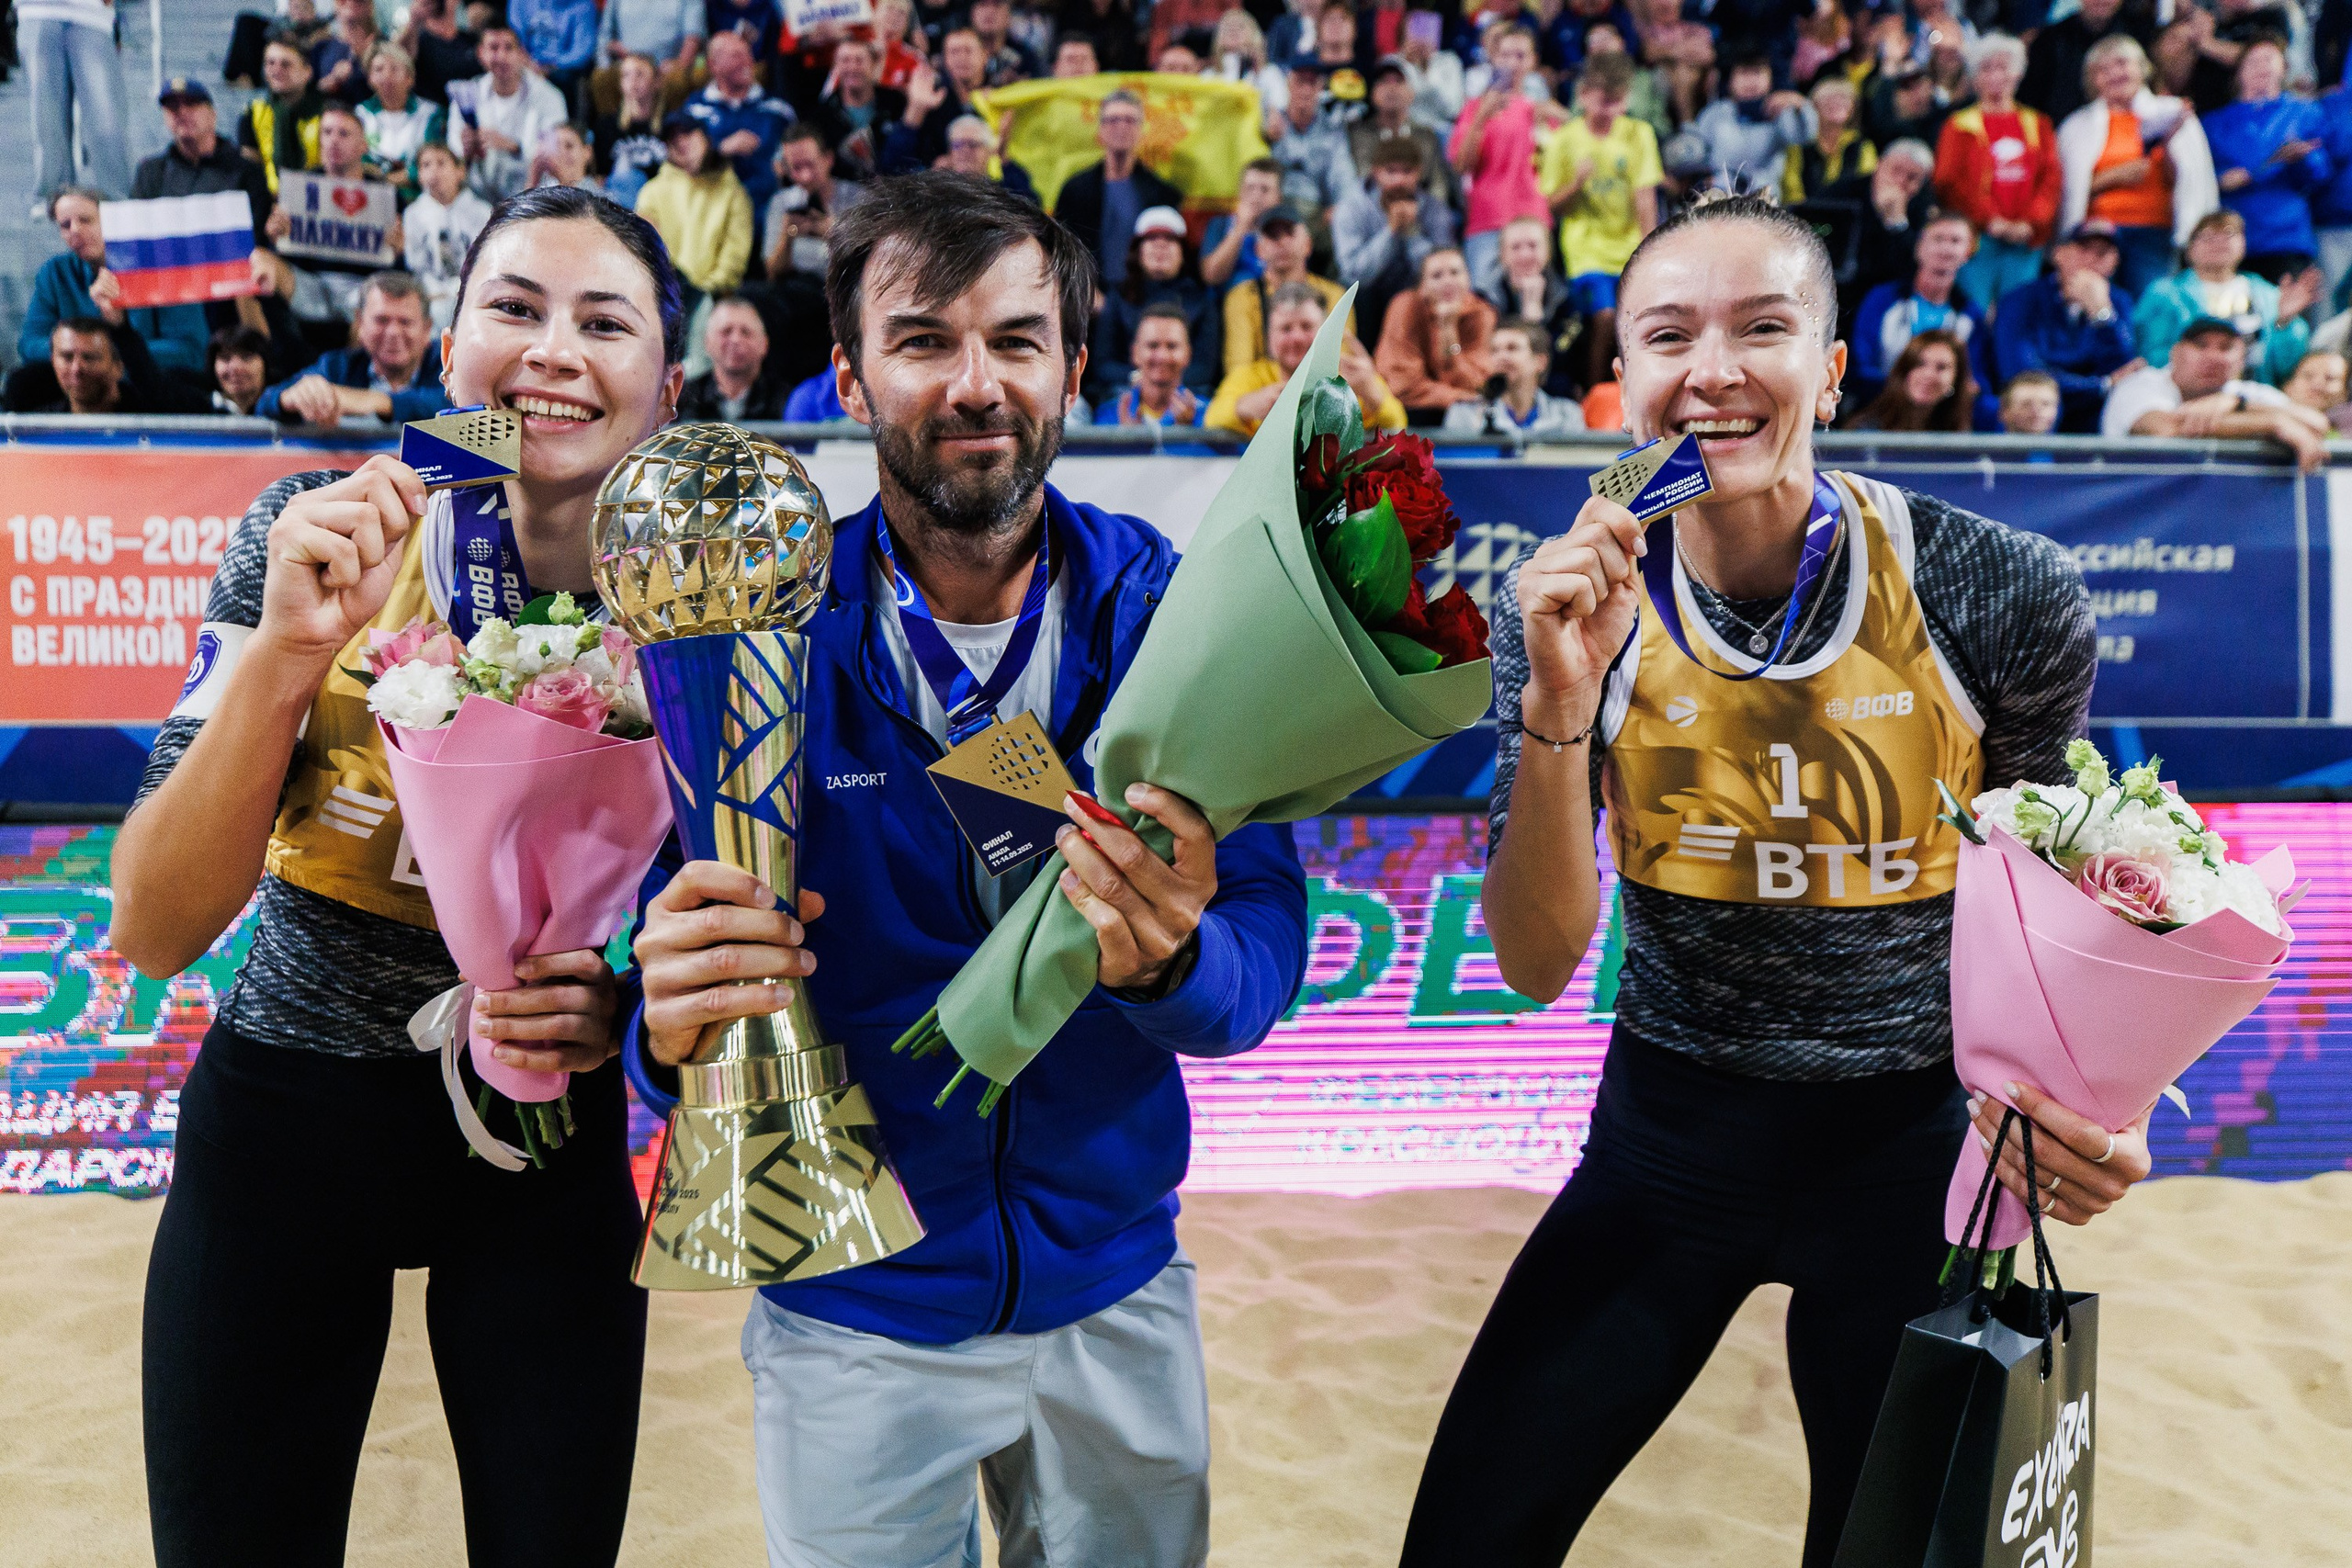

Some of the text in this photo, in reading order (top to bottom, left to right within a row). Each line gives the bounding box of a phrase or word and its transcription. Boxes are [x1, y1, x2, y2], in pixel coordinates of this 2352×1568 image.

[1634, 483, 1705, 518] ЯЖНЫЙ ВОЛЕЙБОЛ
[1644, 471, 1702, 501] ЧЕМПИОНАТ
[1665, 477, 1703, 499] РОССИИ
[10, 575, 37, 617] С
[11, 619, 187, 666] ВЕЛИКОЙ
[1852, 691, 1914, 720] ВФВ
[826, 773, 888, 790] ZASPORT
[1770, 743, 1808, 818] 1
[981, 830, 1013, 851] ФИНАЛ
[988, 846, 1011, 861] АНАПА
[991, 841, 1034, 867] 11-14.09.2025
[1754, 837, 1920, 898] ВТБ
